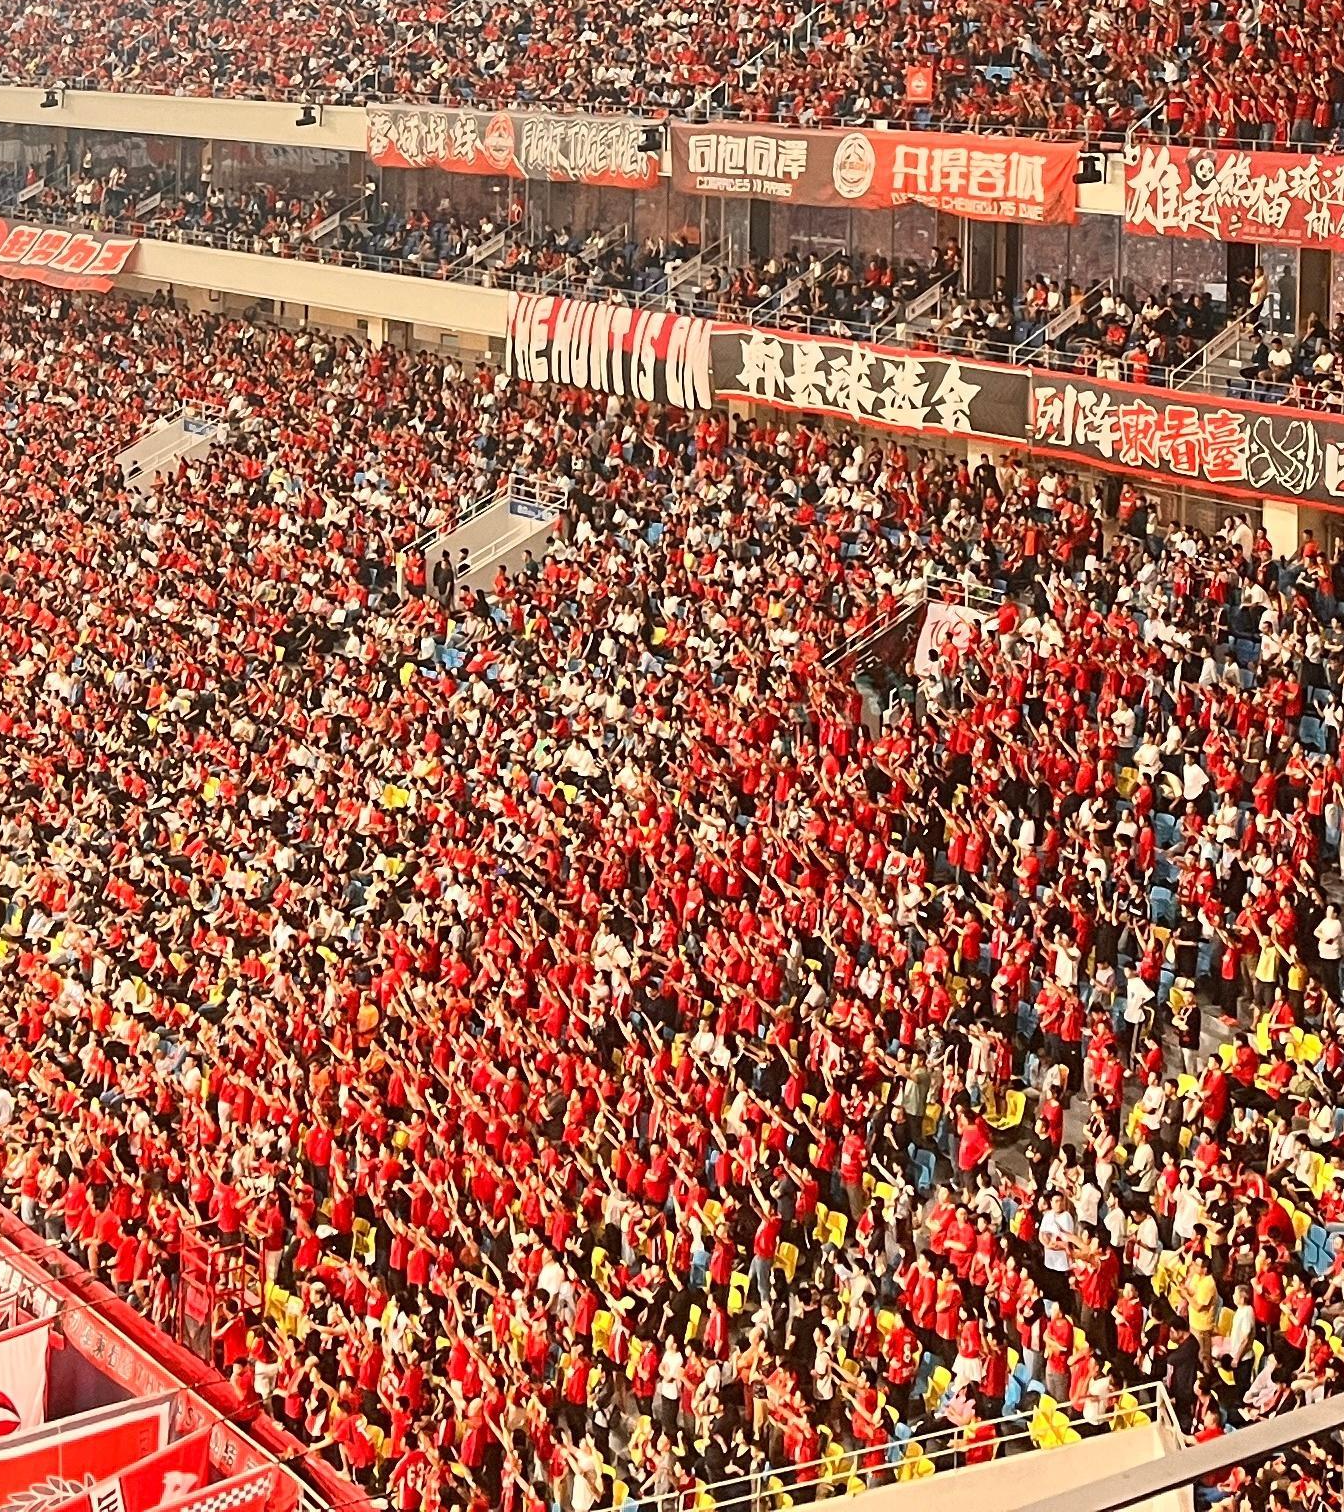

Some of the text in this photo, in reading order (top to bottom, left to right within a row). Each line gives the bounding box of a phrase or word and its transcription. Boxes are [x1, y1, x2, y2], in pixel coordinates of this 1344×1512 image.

[521, 117, 567, 171] FIGHT
[552, 297, 633, 396] HUNT
[630, 309, 667, 402] IS
[665, 316, 712, 411] ON
